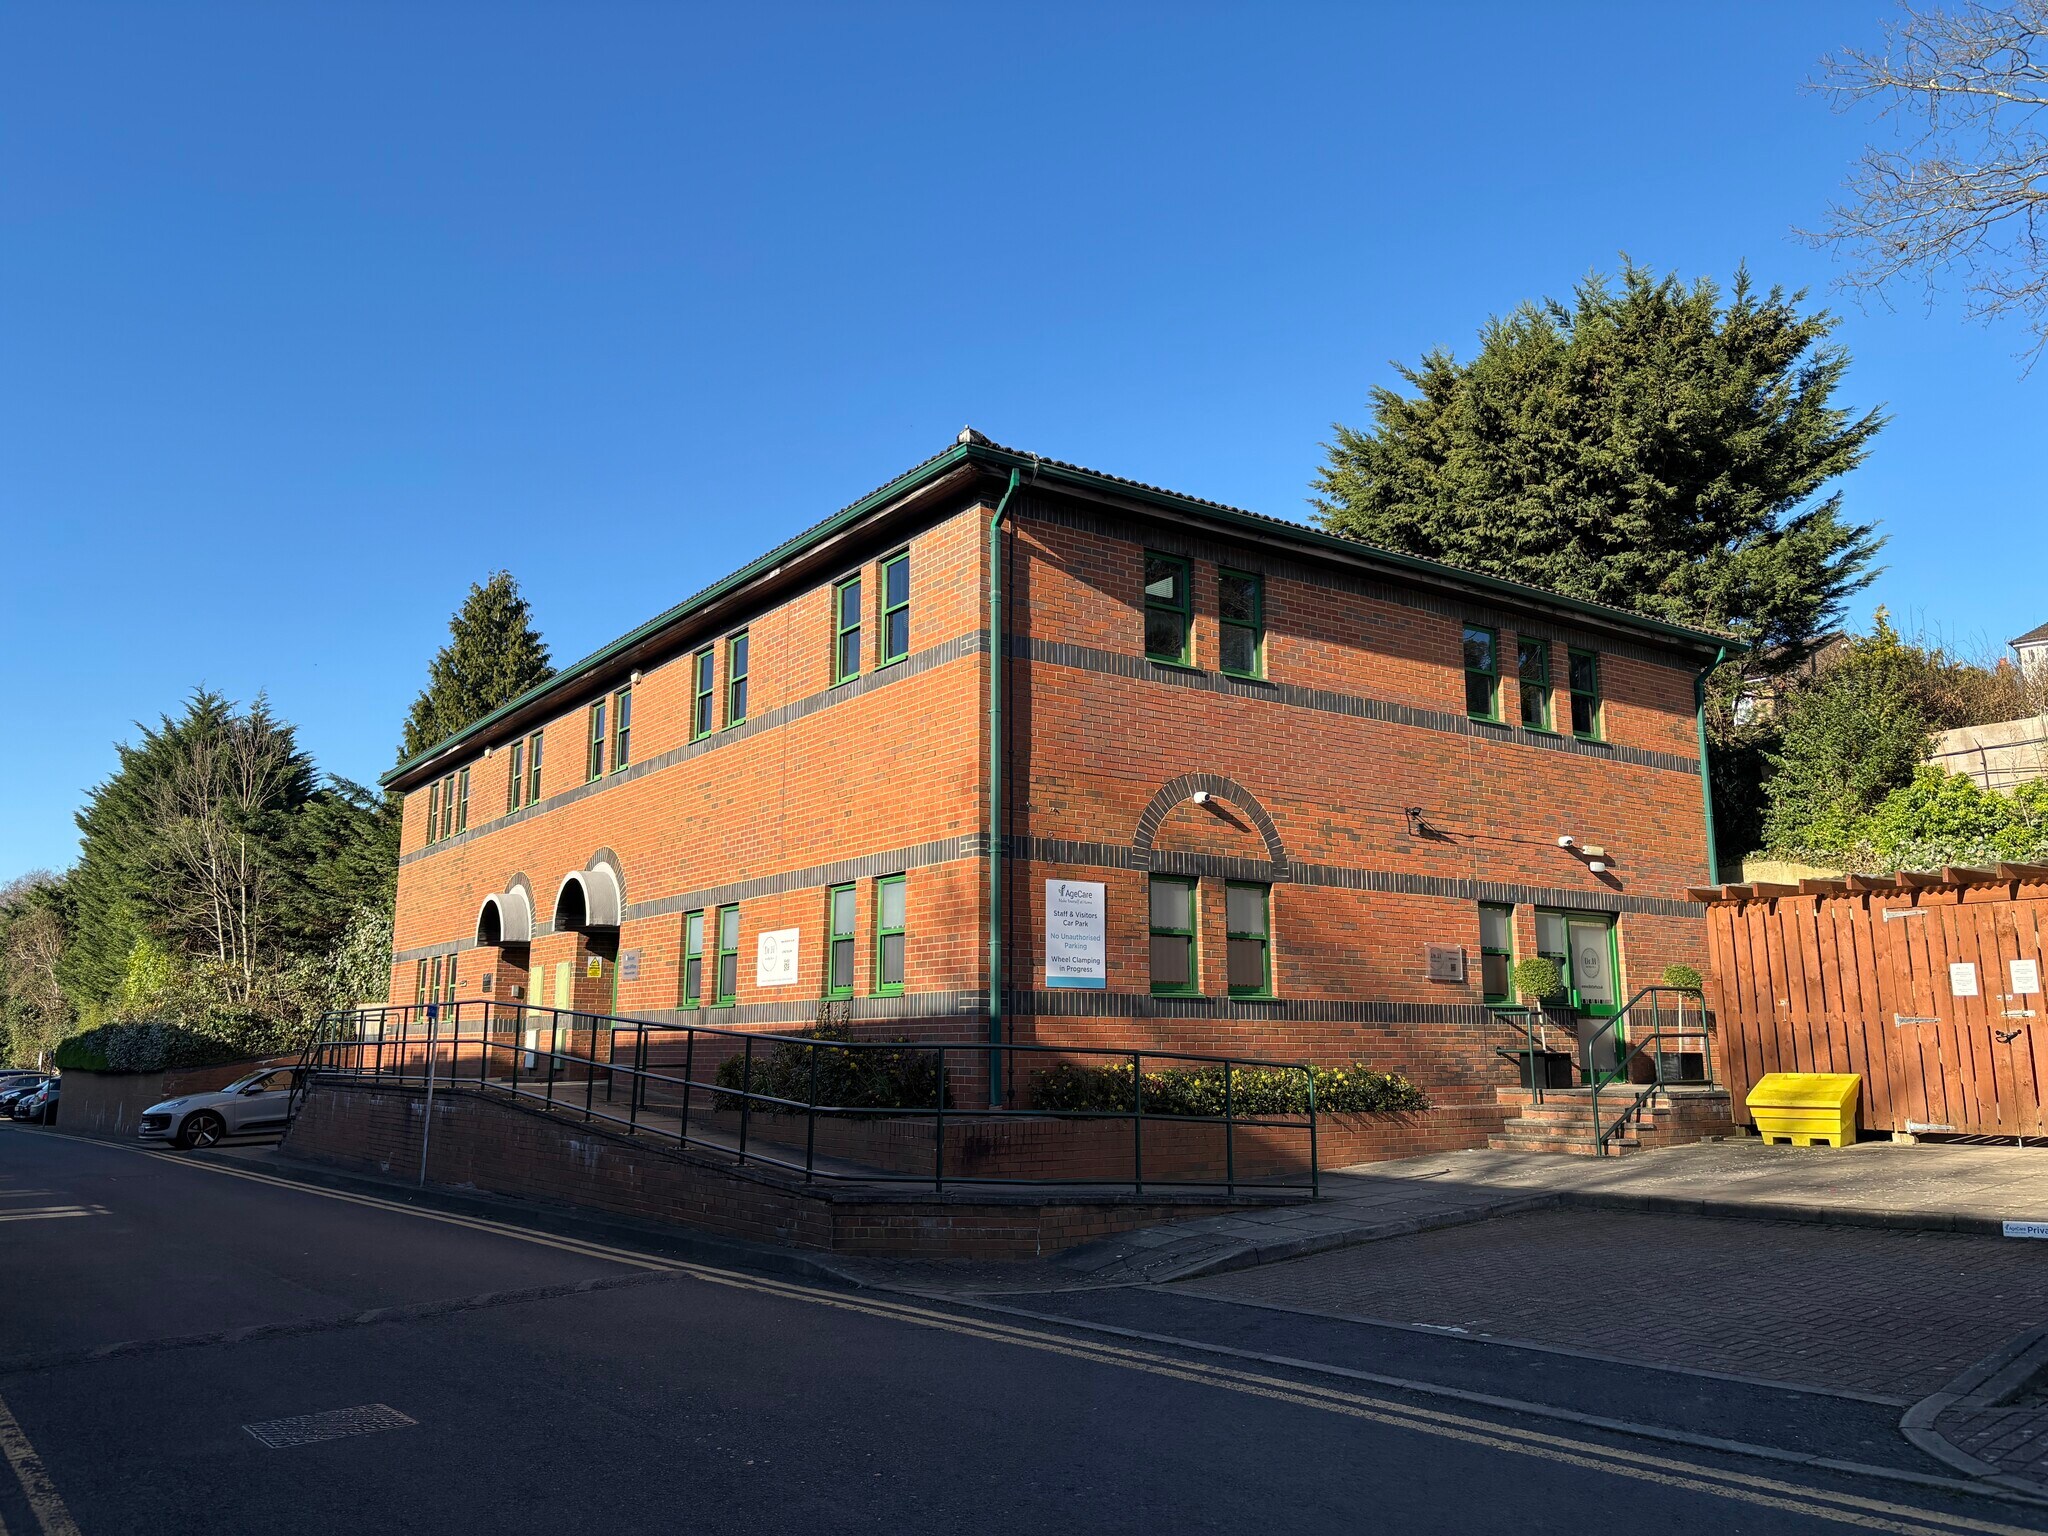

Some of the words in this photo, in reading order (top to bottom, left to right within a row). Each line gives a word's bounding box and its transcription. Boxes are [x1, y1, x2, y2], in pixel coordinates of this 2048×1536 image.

[1065, 890, 1093, 899] AgeCare
[1075, 911, 1098, 919] Visitors
[1061, 933, 1101, 941] Unauthorised
[1072, 957, 1101, 965] Clamping
[1066, 965, 1093, 973] Progress
